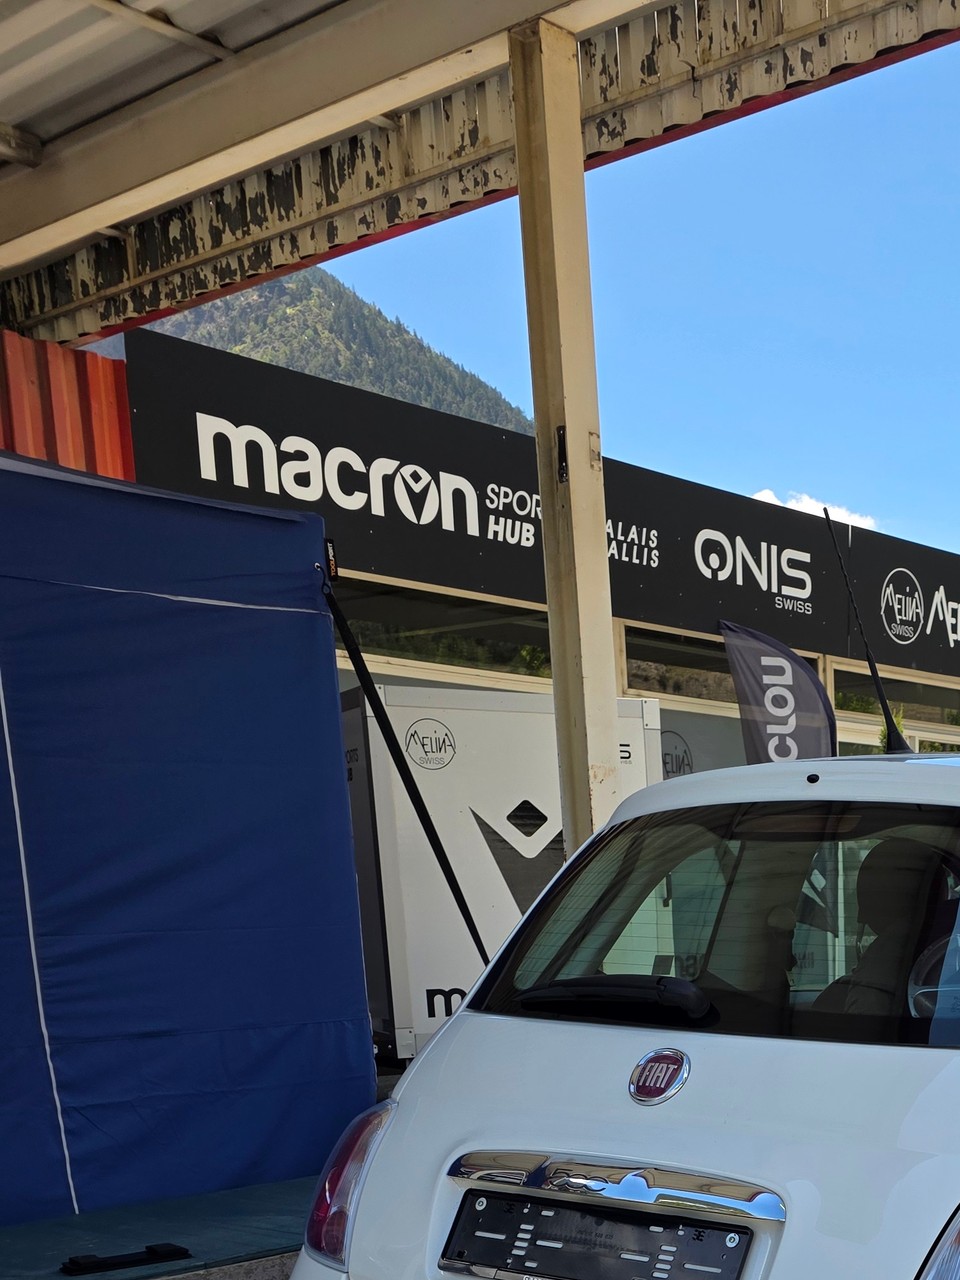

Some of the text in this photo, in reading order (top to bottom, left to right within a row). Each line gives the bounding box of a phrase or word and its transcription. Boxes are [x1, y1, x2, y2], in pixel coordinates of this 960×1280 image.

[196, 412, 542, 537] macron SPOR
[487, 515, 535, 548] HUB
[605, 519, 658, 548] ALAIS
[607, 540, 660, 568] ALLIS
[694, 528, 812, 599] ONIS
[775, 596, 813, 615] SWISS
[890, 623, 914, 638] SWISS
[419, 757, 445, 766] SWISS
[638, 1062, 678, 1089] FIAT
